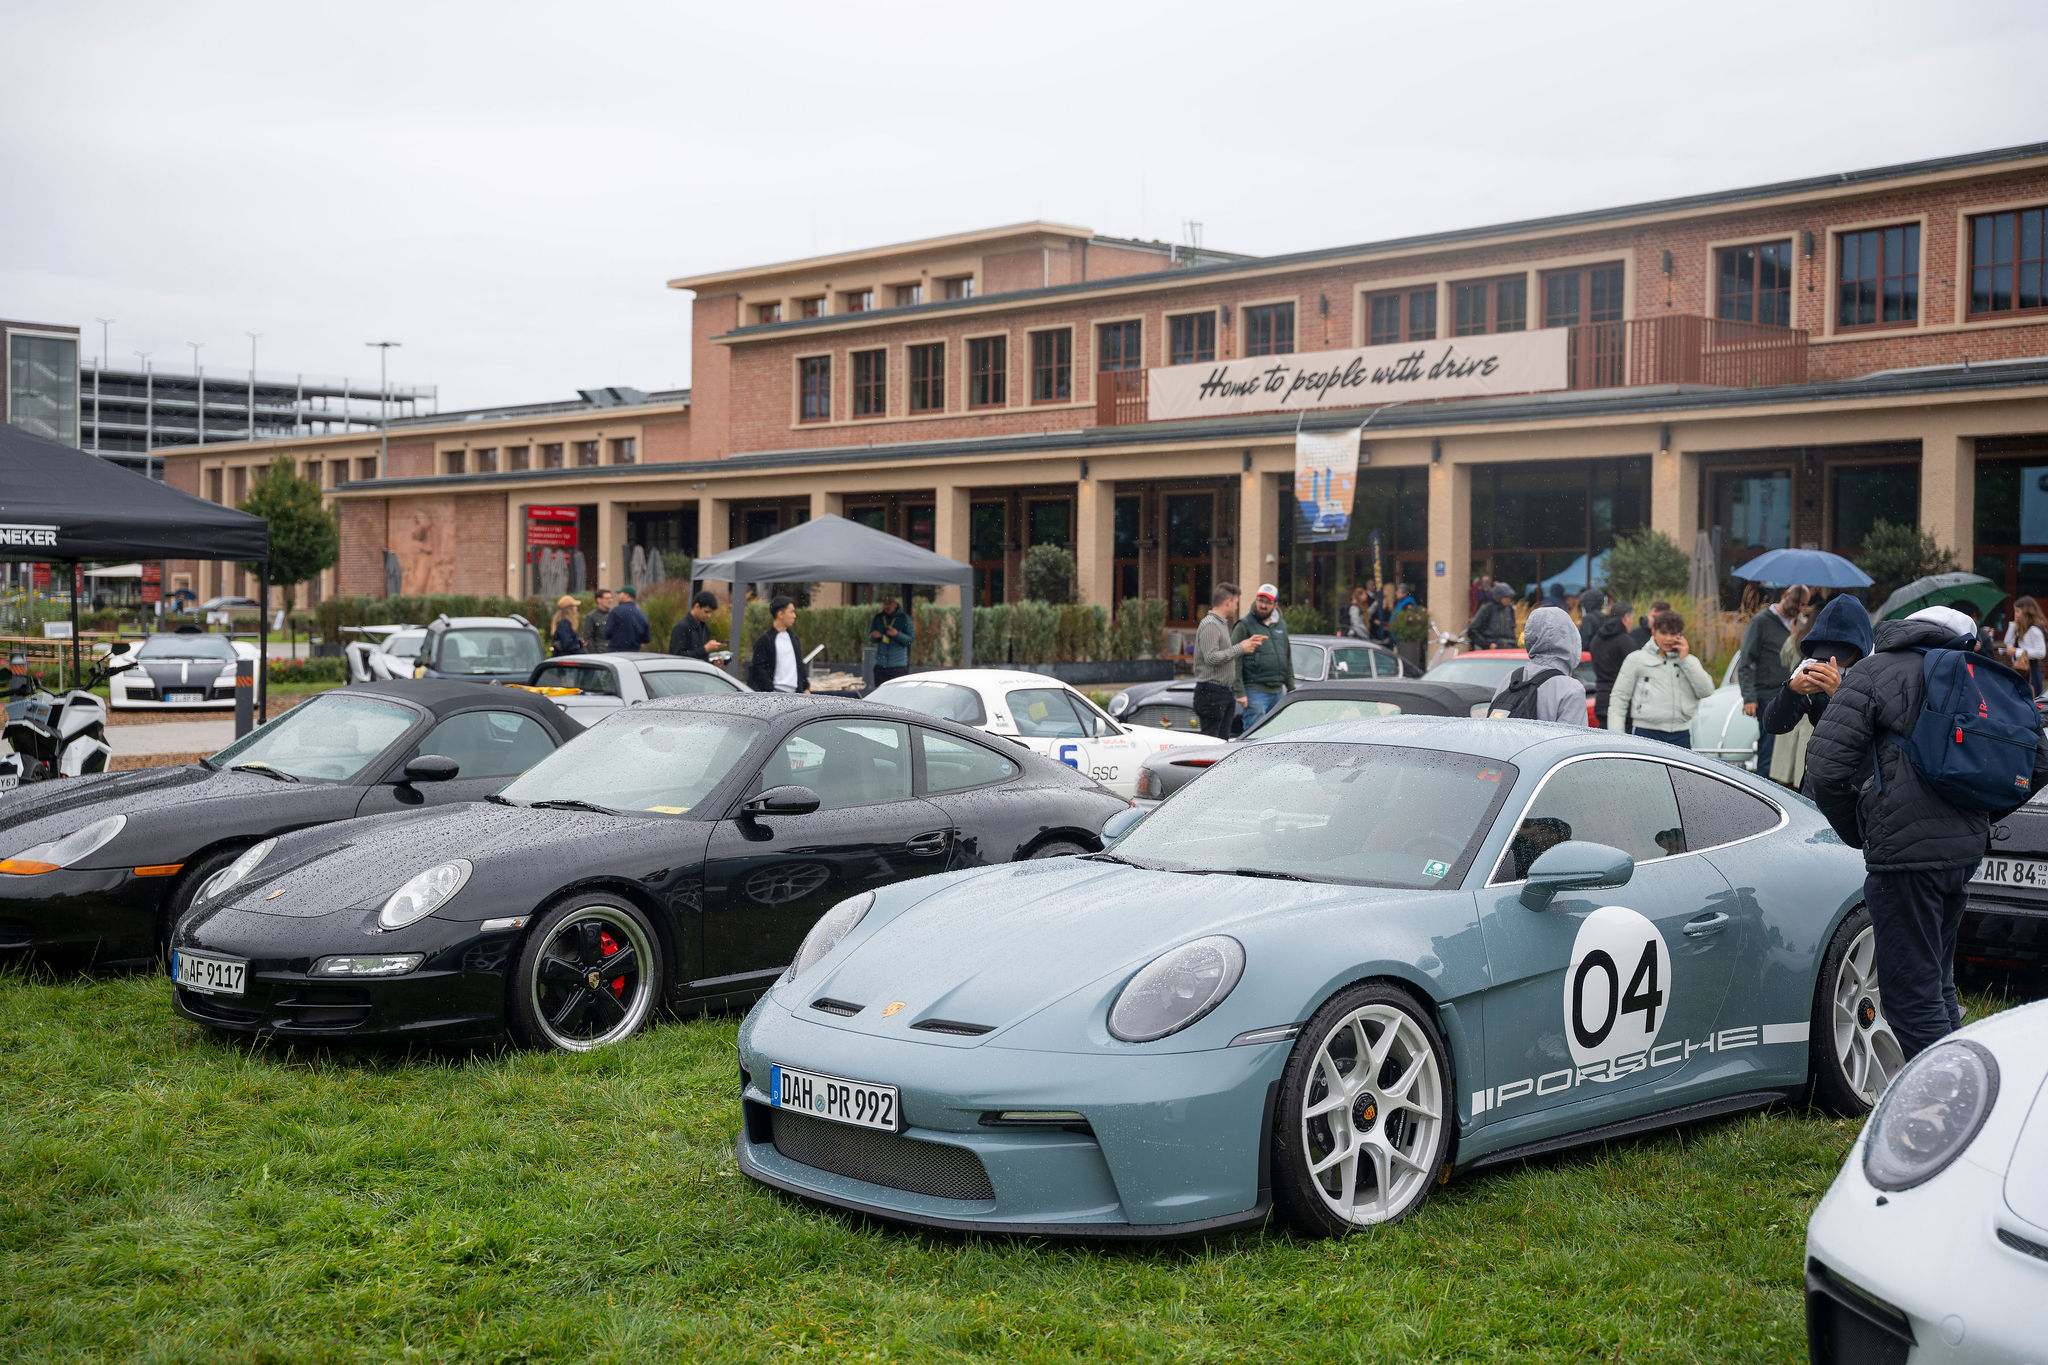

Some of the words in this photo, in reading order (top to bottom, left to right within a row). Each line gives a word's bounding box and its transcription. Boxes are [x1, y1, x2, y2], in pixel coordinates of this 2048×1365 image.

[1199, 366, 1260, 401] Home
[1263, 364, 1290, 394] to
[1281, 356, 1367, 404] people
[1371, 349, 1425, 386] with
[1428, 344, 1500, 380] drive
[0, 529, 57, 546] NEKER
[1092, 766, 1118, 781] SSC
[1983, 860, 2008, 882] AR
[2013, 862, 2036, 884] 84
[2038, 864, 2048, 872] 03
[178, 956, 184, 980] M
[190, 959, 204, 983] AF
[207, 962, 244, 989] 9117
[1571, 938, 1664, 1049] 04
[1496, 1025, 1758, 1108] PORSCHE
[781, 1072, 813, 1110] DAH
[827, 1082, 851, 1119] PR
[854, 1088, 894, 1126] 992
